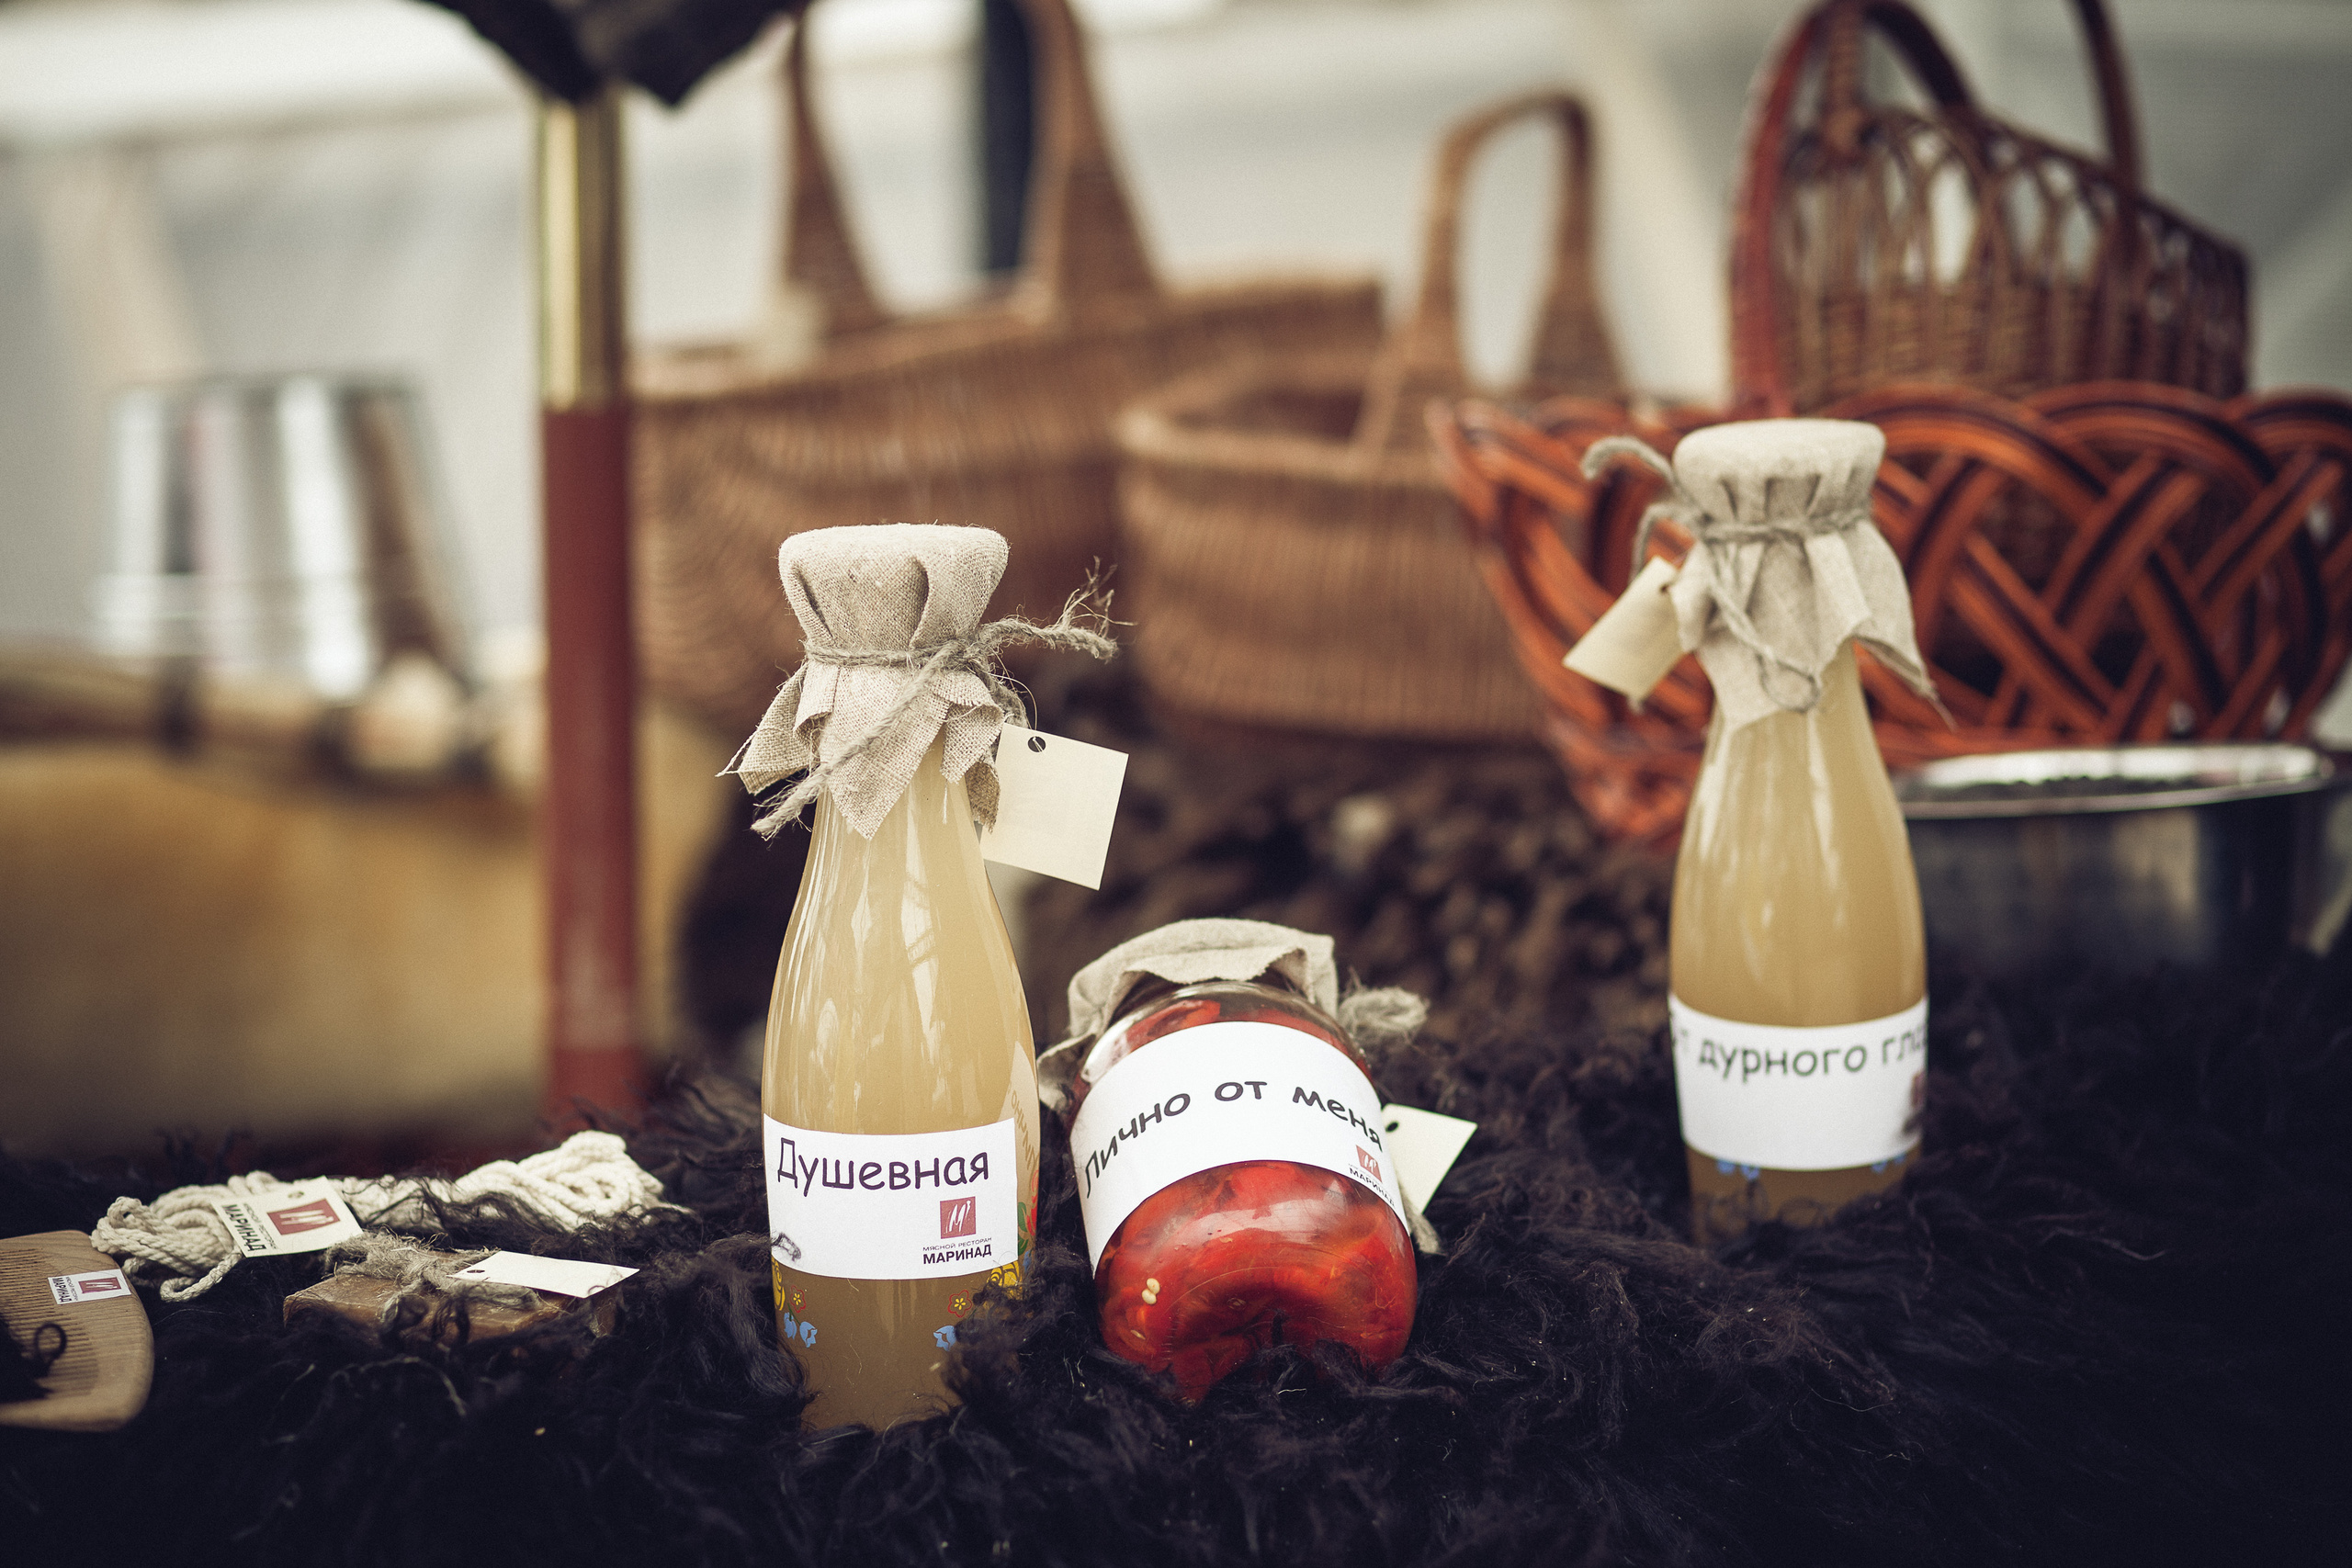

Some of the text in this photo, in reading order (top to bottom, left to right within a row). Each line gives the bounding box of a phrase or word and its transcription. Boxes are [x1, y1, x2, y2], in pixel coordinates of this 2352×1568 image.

[1699, 1038, 1868, 1083] дурного
[1085, 1080, 1383, 1200] Лично от меня
[777, 1137, 989, 1197] Душевная
[221, 1204, 267, 1252] МАРИНАД
[958, 1237, 992, 1247] РЕСТОРАН
[922, 1244, 991, 1264] МАРИНАД
